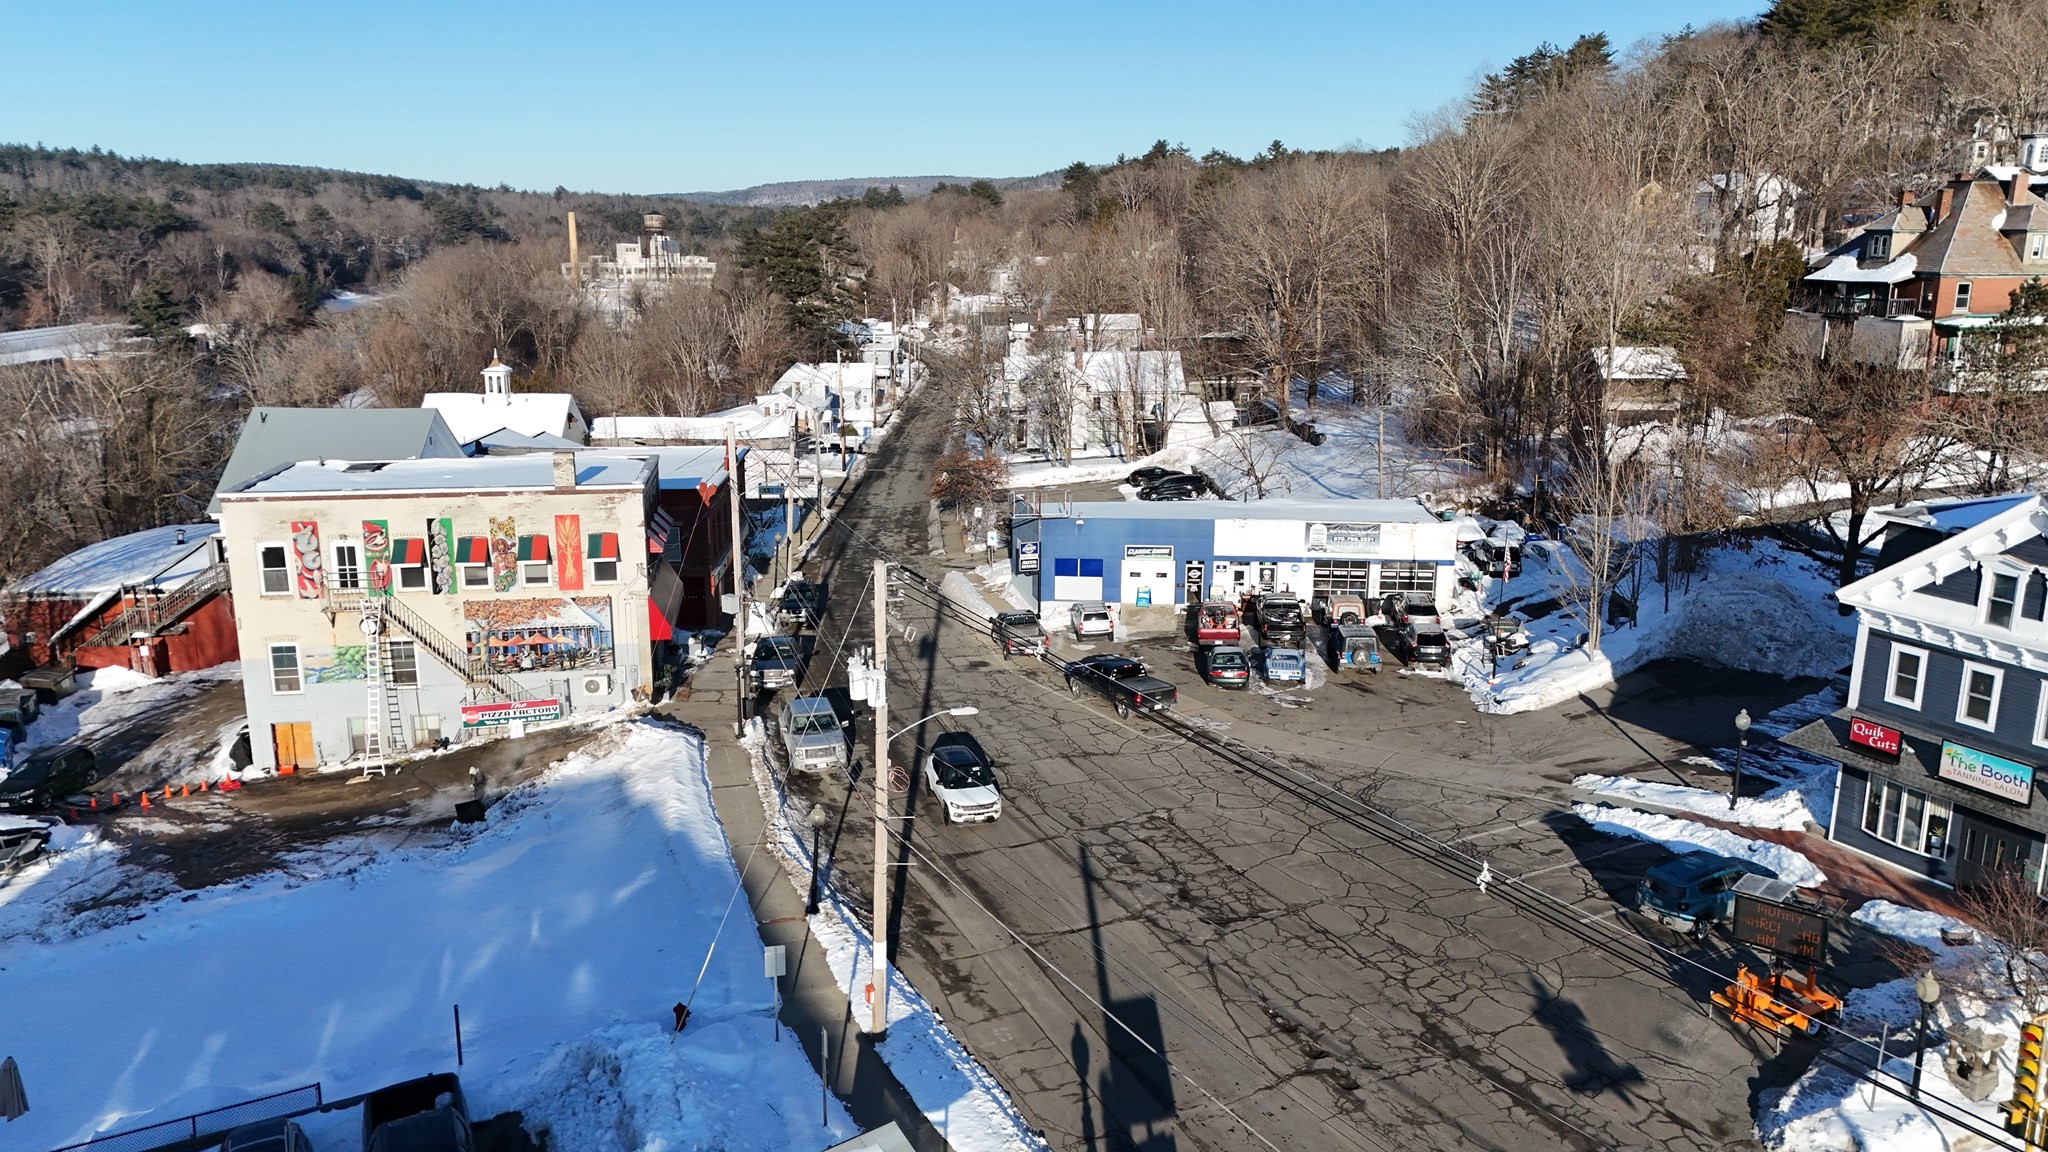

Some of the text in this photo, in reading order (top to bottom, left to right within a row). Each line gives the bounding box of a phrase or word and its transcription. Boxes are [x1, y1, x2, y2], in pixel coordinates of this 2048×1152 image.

[481, 710, 510, 719] PIZZA
[513, 706, 558, 716] FACTORY
[1853, 723, 1884, 738] Quik
[1869, 736, 1897, 750] Cutz
[1945, 749, 2029, 790] The Booth
[1952, 768, 2024, 798] TANNING SALON
